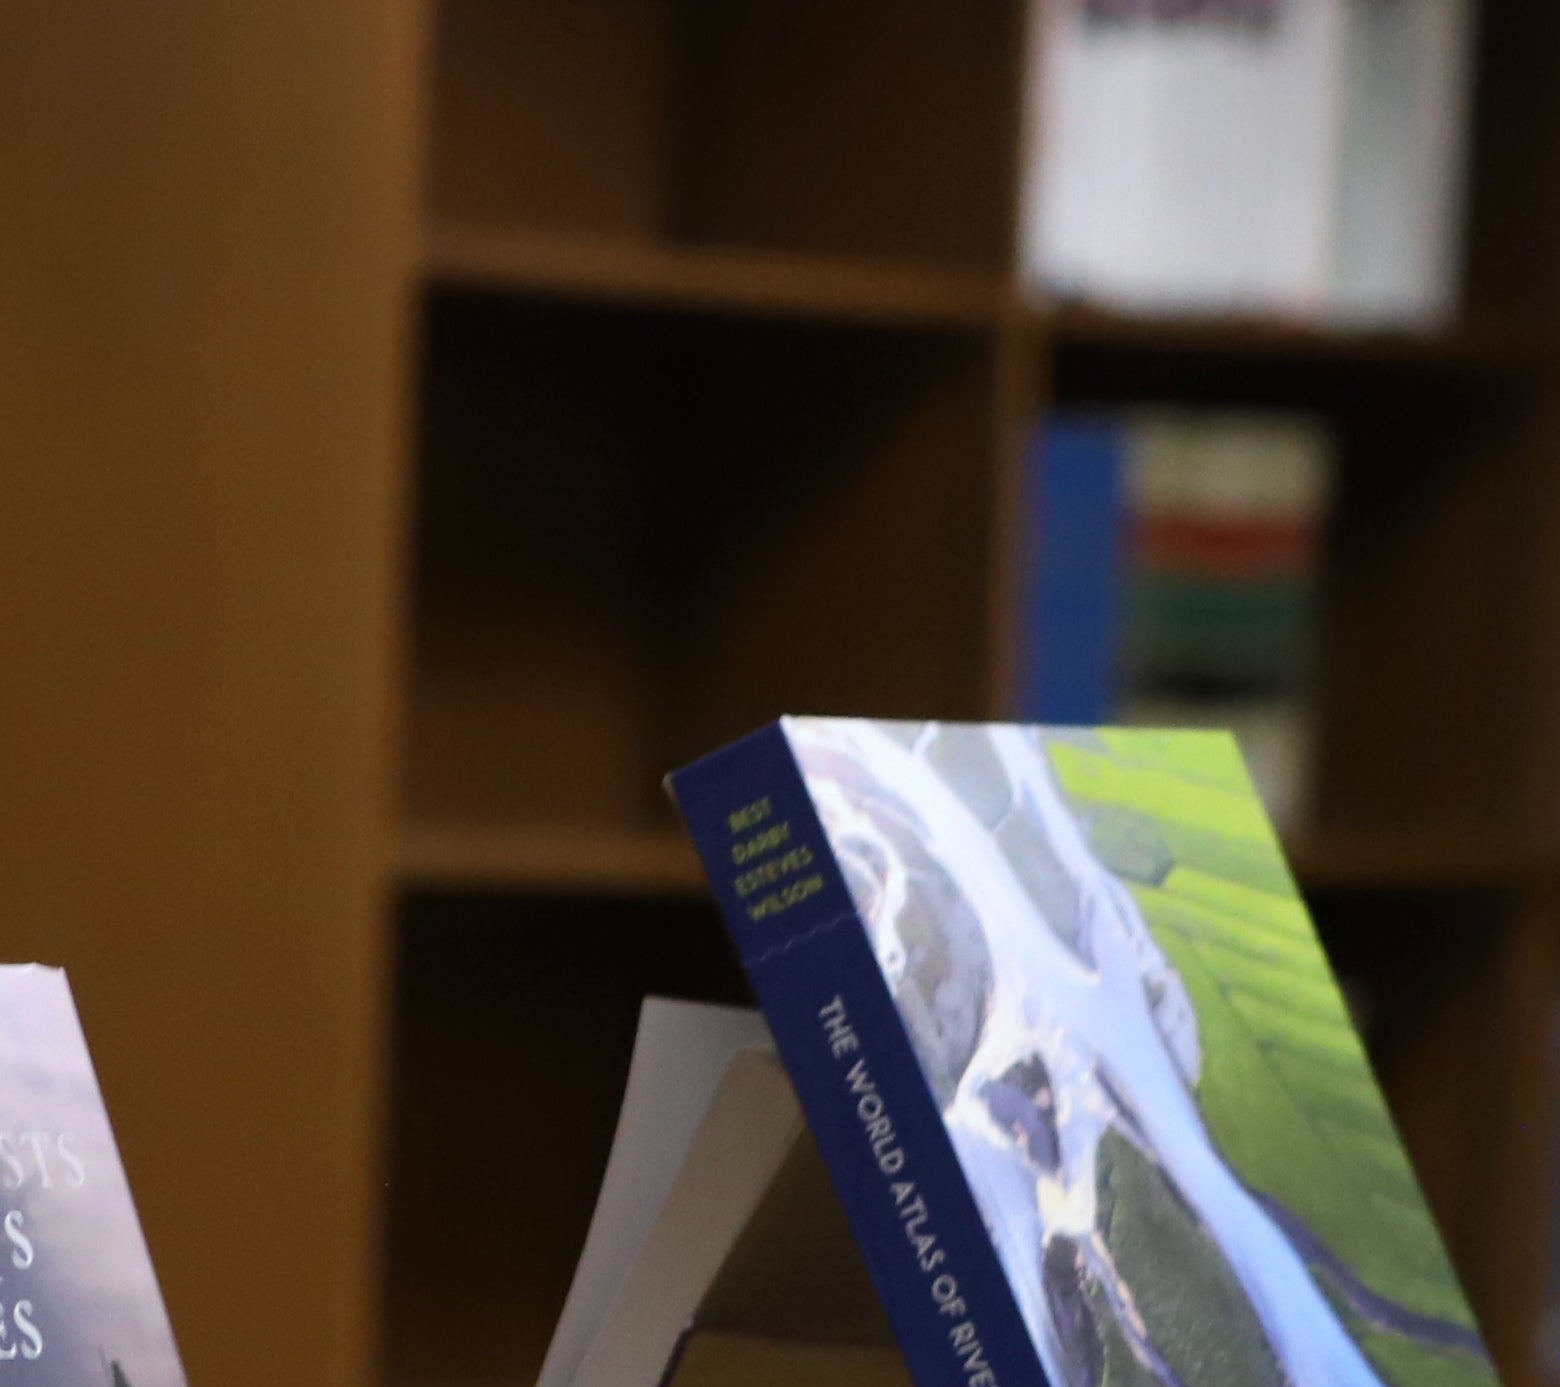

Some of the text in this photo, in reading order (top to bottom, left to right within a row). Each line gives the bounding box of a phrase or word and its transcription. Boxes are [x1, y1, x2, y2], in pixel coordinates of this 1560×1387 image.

[734, 848, 813, 897] ESTEVES
[747, 875, 823, 920] WILSON
[817, 997, 860, 1060] THE
[845, 1061, 904, 1173] WORLD
[890, 1177, 944, 1273] ATLAS
[931, 1274, 968, 1320] OF
